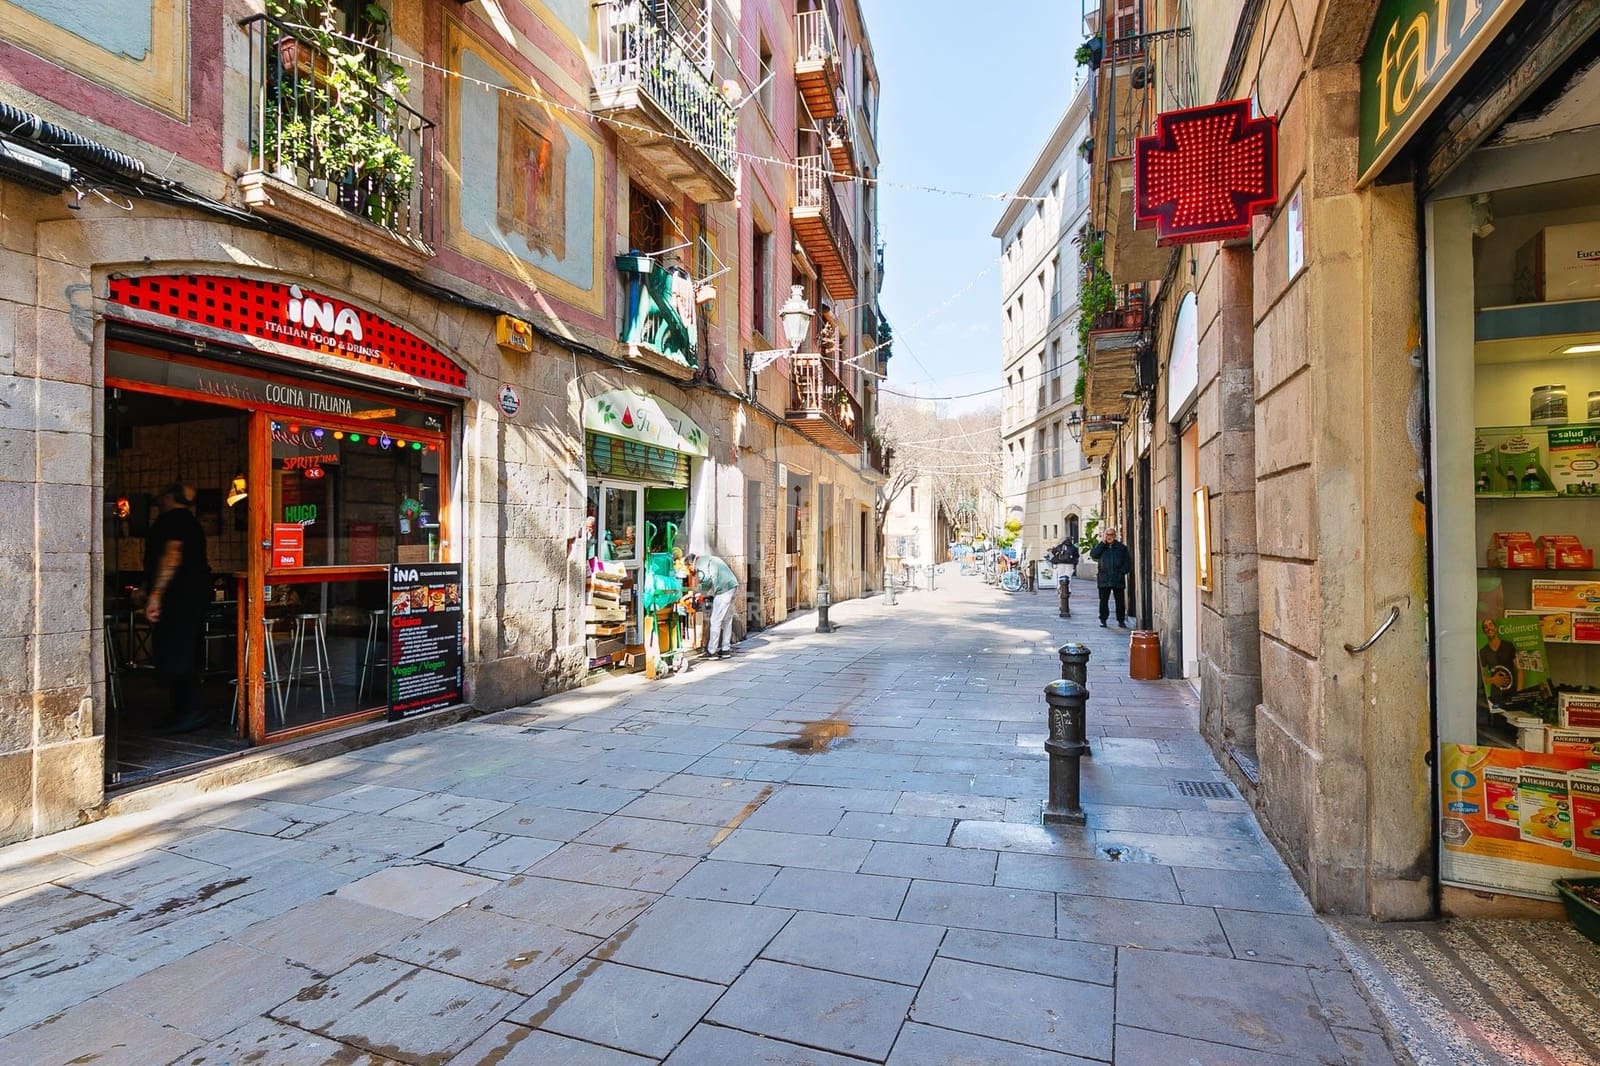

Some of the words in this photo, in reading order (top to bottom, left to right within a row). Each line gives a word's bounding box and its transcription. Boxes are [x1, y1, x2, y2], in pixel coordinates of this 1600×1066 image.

[1374, 0, 1483, 146] far
[265, 320, 308, 339] ITALIAN
[310, 332, 337, 347] FOOD
[338, 340, 346, 350] &
[347, 343, 381, 359] DRINKS
[265, 384, 304, 407] COCINA
[309, 392, 352, 416] ITALIANA
[1558, 430, 1584, 438] salud
[309, 469, 320, 478] 2€
[285, 503, 317, 522] HUGO
[393, 566, 419, 582] iNA
[1521, 776, 1567, 790] ARKOREAL
